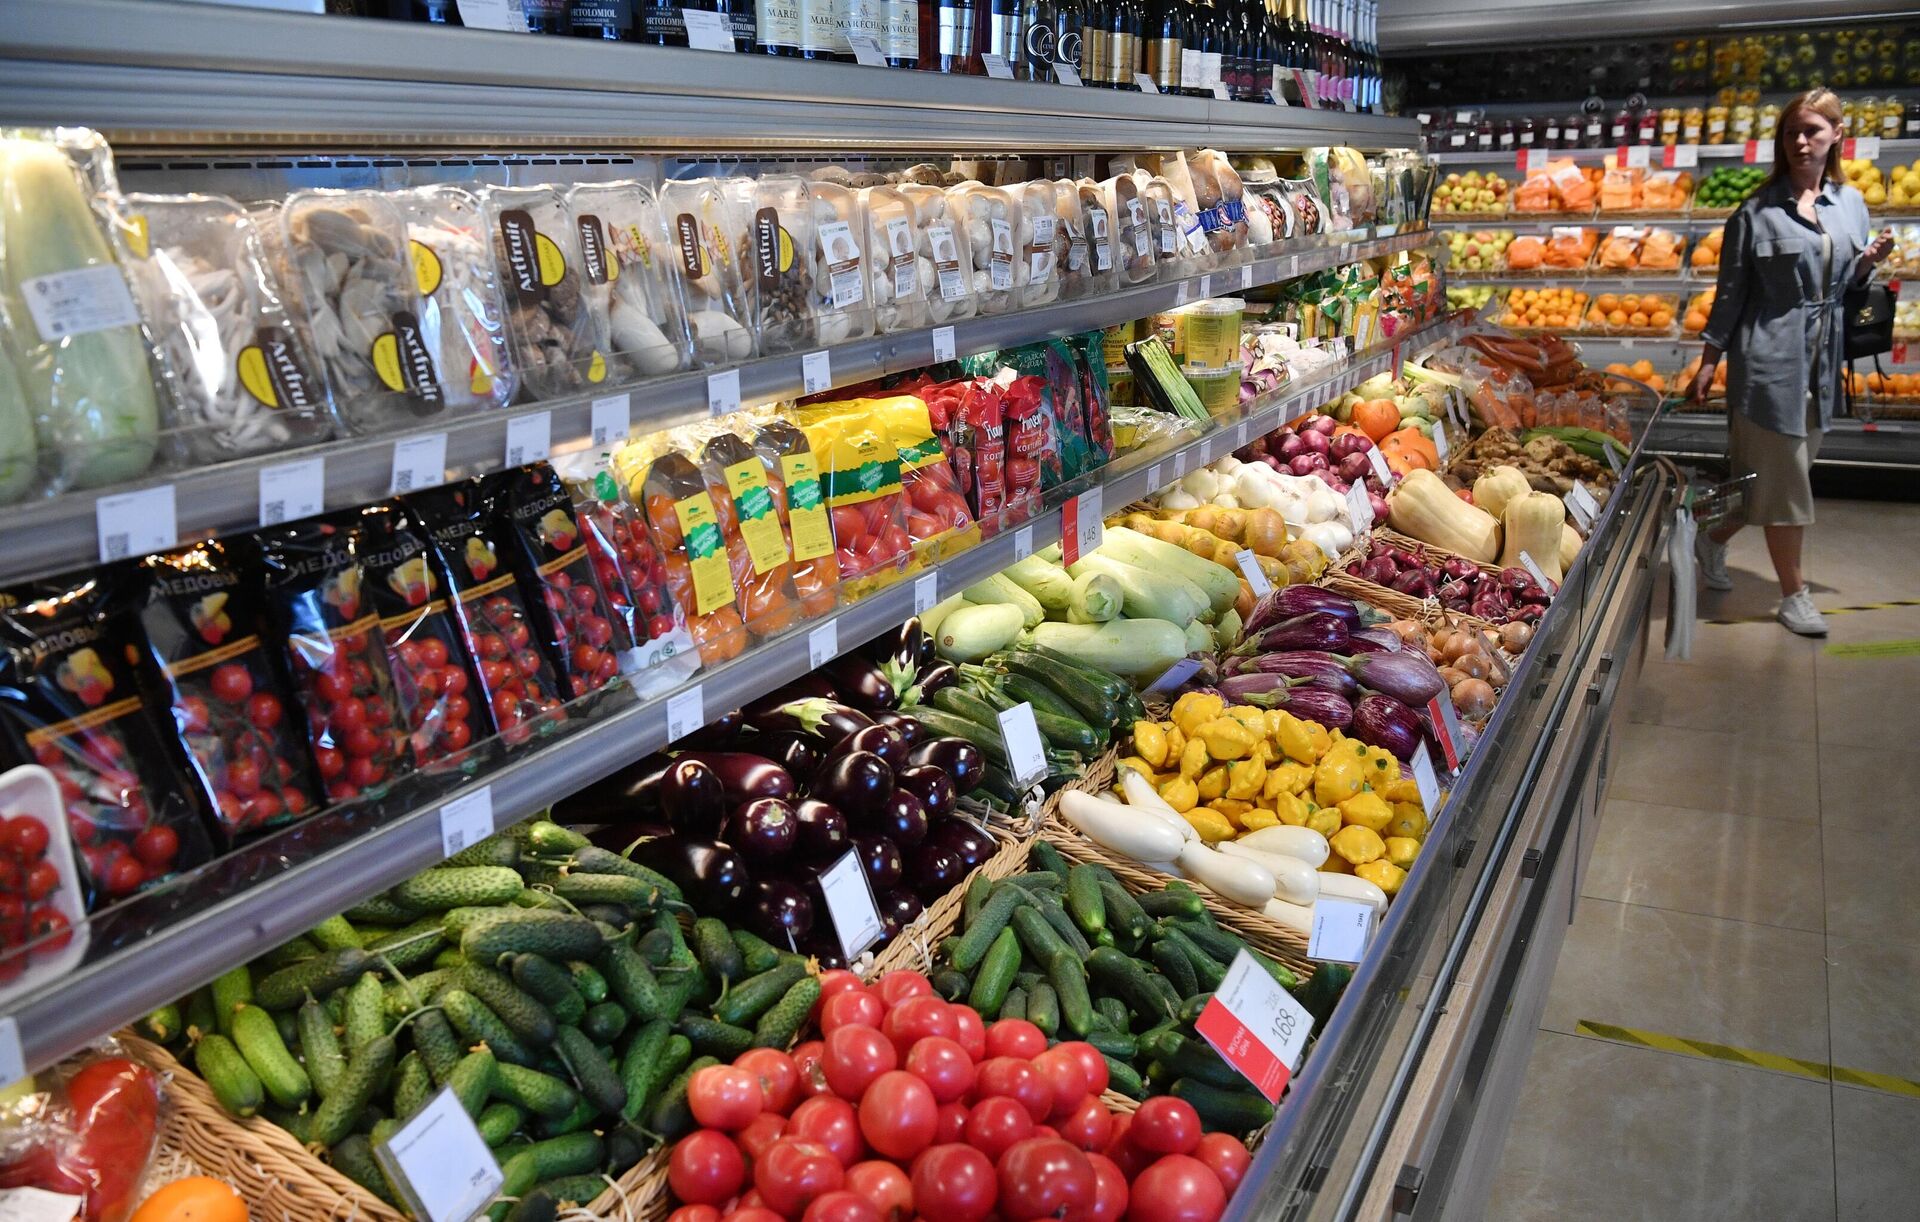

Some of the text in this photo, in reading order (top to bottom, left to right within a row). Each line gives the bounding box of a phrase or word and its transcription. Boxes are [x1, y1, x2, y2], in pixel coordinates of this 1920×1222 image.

[506, 221, 535, 292] Artfruit
[681, 222, 698, 271] Artfruit
[759, 217, 774, 277] Artfruit
[268, 341, 316, 418] Artfruit
[402, 326, 438, 401] Artfruit
[1083, 526, 1096, 545] 148
[1271, 1008, 1296, 1047] 168
